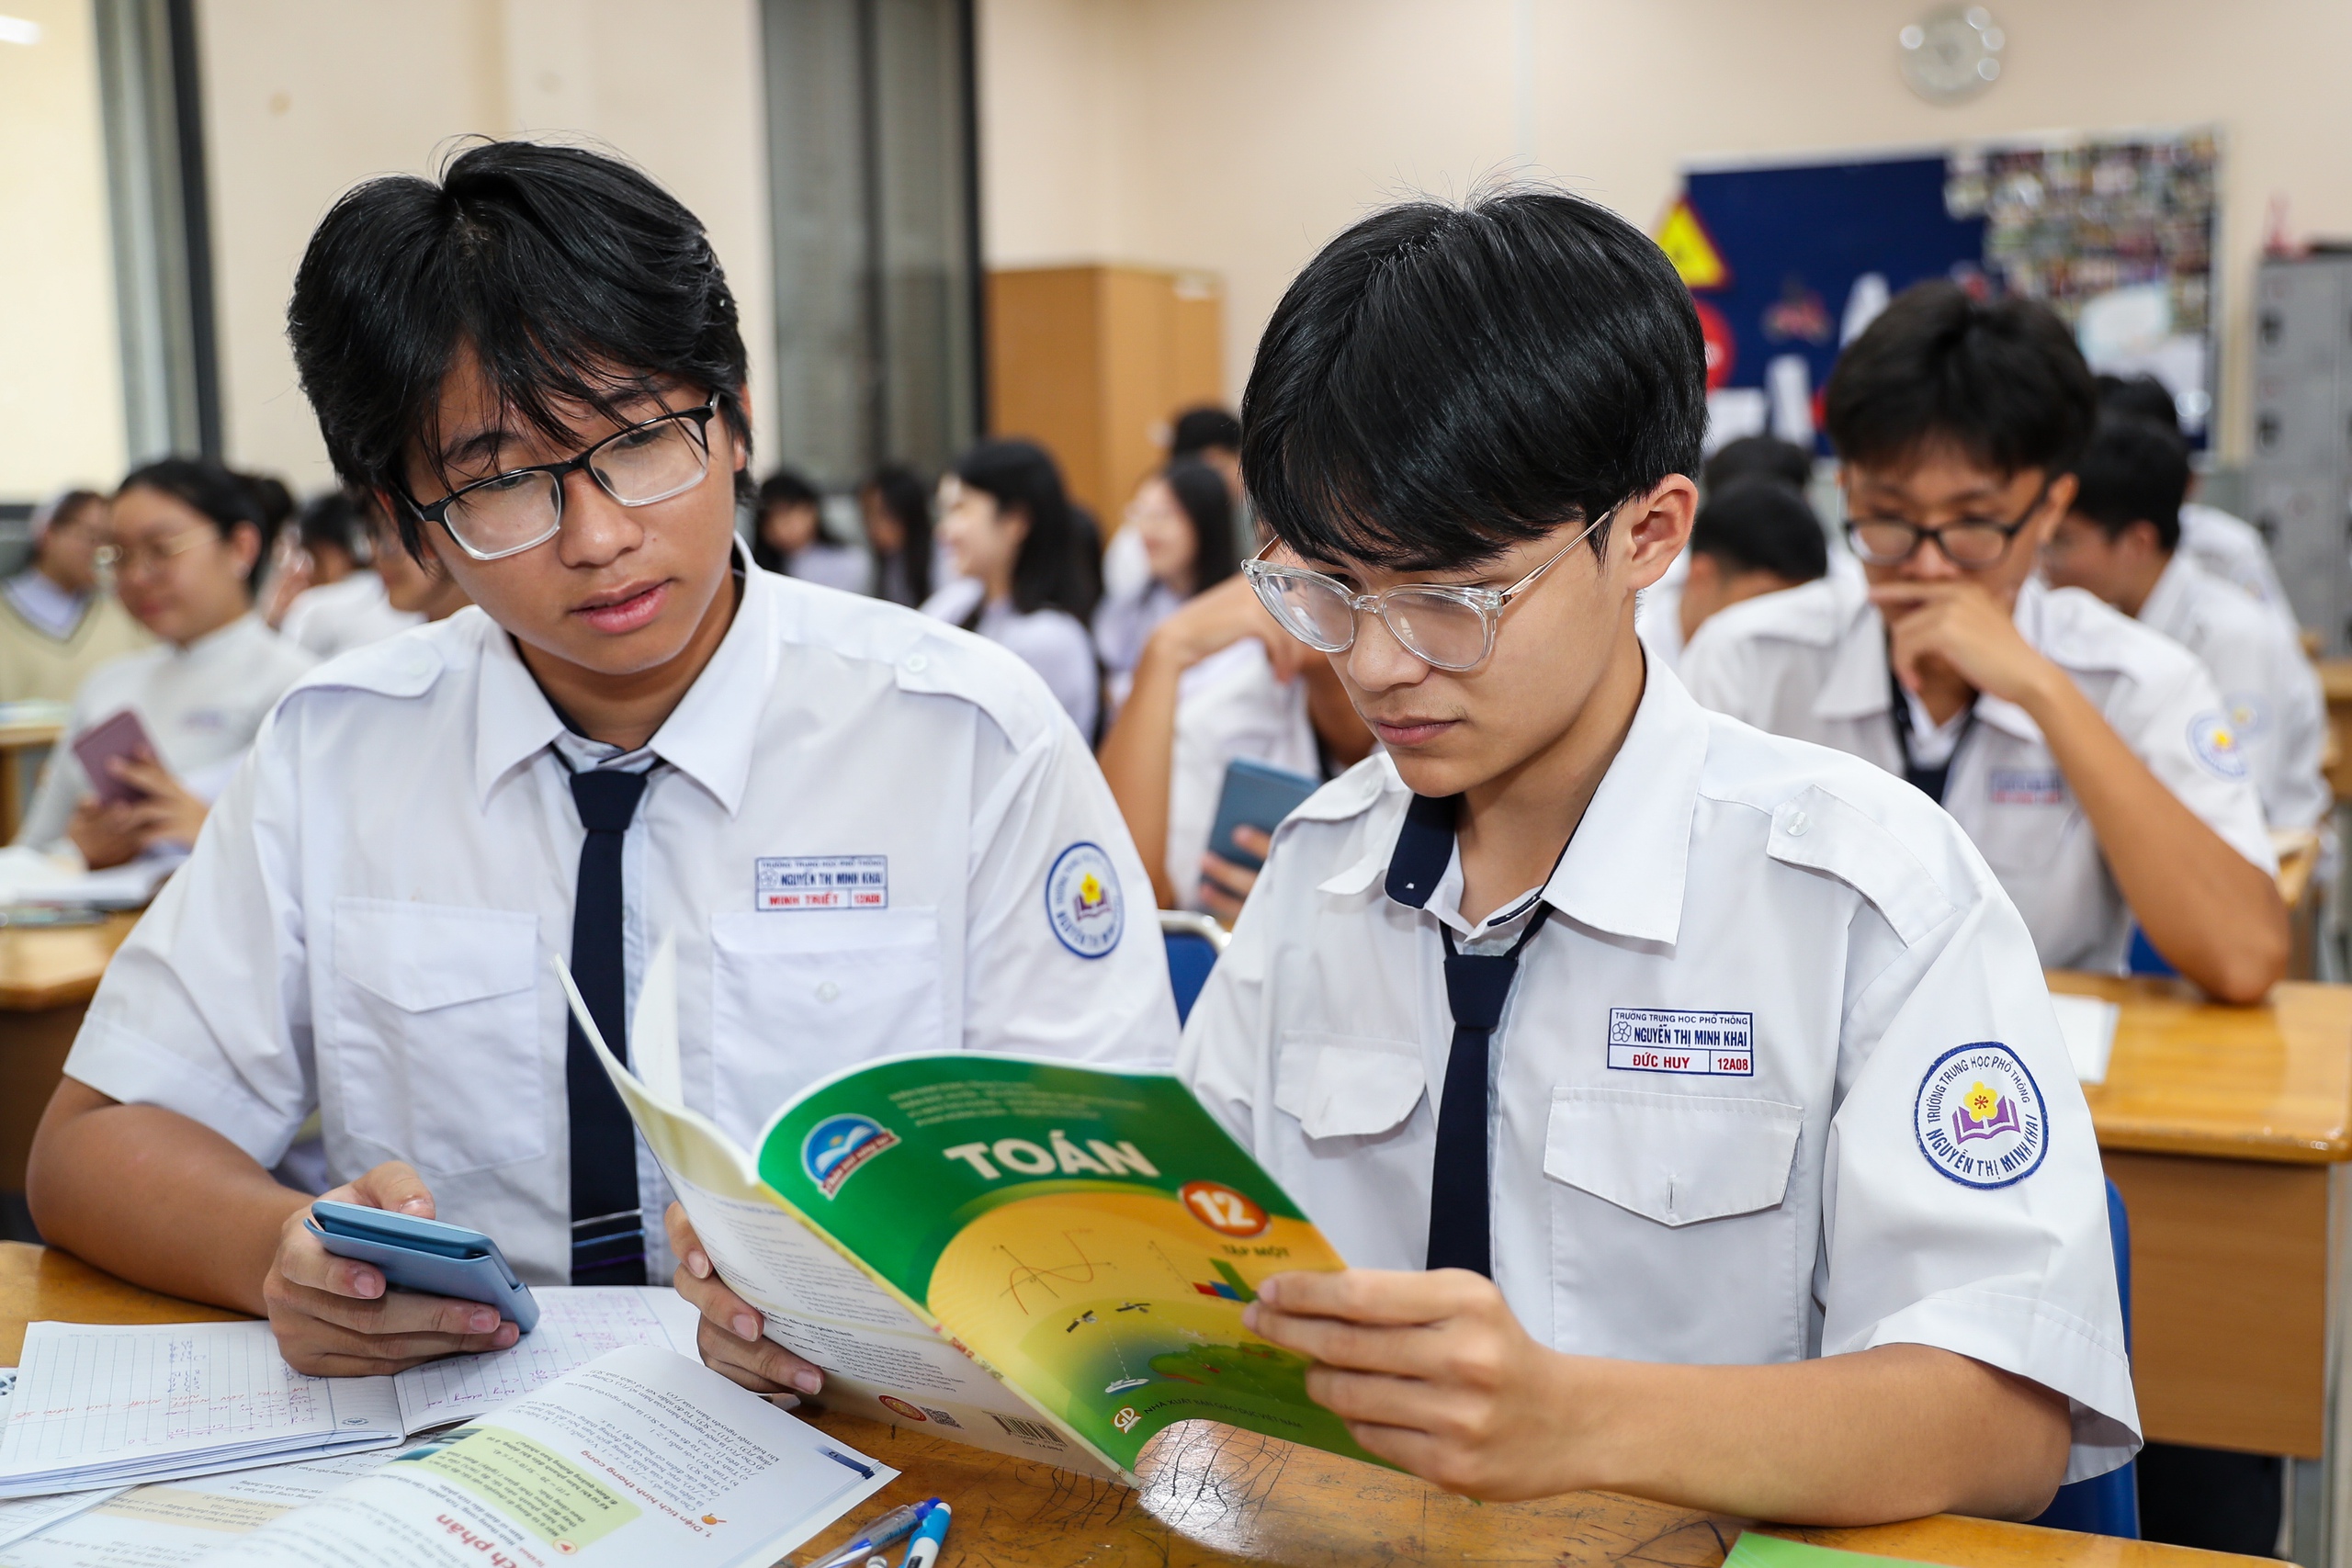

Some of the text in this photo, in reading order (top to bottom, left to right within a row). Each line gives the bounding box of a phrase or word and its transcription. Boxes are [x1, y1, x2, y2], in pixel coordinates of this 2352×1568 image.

[836, 872, 858, 885] MINH
[1615, 1010, 1747, 1025] TRƯỜNG TRUNG HỌC PHỔ THÔNG
[1634, 1024, 1747, 1047] NGUYỄN THỊ MINH KHAI
[1633, 1052, 1690, 1069] ĐỨC HUY
[1717, 1058, 1748, 1071] 12A08
[1926, 1055, 2030, 1124] TRƯỜNG TRUNG HỌC PHỔ THÔNG
[1926, 1113, 2039, 1180] NGUYỄN THỊ MINH KHAI
[943, 1129, 1160, 1181] TOÁN
[1189, 1190, 1258, 1227] 12
[578, 1383, 594, 1392] hàm
[595, 1389, 622, 1402] nguyên
[639, 1393, 654, 1402] hàm
[621, 1401, 636, 1410] một
[653, 1400, 666, 1409] của
[1144, 1401, 1168, 1414] NHÀ
[1167, 1397, 1193, 1406] XUẤT
[554, 1406, 576, 1416] vuông
[666, 1408, 680, 1418] hàm
[1114, 1406, 1136, 1429] GD
[568, 1419, 581, 1428] bởi
[605, 1422, 616, 1430] và
[681, 1417, 706, 1434] nguyên
[582, 1427, 595, 1436] hạn
[622, 1432, 633, 1440] độ
[667, 1429, 681, 1438] suy
[683, 1401, 779, 1463] khi biết một nguyên hàm của
[596, 1435, 612, 1444] giới
[680, 1437, 690, 1445] đó
[705, 1433, 719, 1442] một
[515, 1441, 540, 1453] nhiêu?
[611, 1444, 631, 1459] thang
[621, 1442, 634, 1451] hai
[634, 1439, 655, 1455] hoành
[690, 1444, 700, 1453] Từ
[520, 1450, 532, 1459] khi
[540, 1452, 553, 1461] bao
[581, 1450, 605, 1467] cong
[633, 1449, 643, 1458] và
[532, 1457, 545, 1466] đến
[633, 1459, 650, 1471] hình
[644, 1457, 666, 1472] hoành
[668, 1440, 740, 1487] b) Tính S(x) với mỗi
[741, 1456, 756, 1466] Cho
[545, 1465, 568, 1479] phanh
[553, 1460, 574, 1474] đường
[666, 1461, 684, 1473] điểm
[722, 1464, 739, 1476] Tính
[331, 1469, 353, 1477] dương
[606, 1467, 635, 1488] thang
[650, 1471, 663, 1480] của
[667, 1472, 681, 1482] trục
[684, 1473, 697, 1483] các
[566, 1479, 582, 1490] hãm
[573, 1473, 594, 1488] quãng
[664, 1480, 678, 1490] tích
[704, 1474, 719, 1486] Tính
[697, 1482, 707, 1490] tại
[581, 1489, 593, 1498] khi
[594, 1488, 610, 1499] được
[636, 1488, 658, 1504] hình
[679, 1490, 695, 1500] diện
[184, 1506, 209, 1515] đường
[659, 1503, 678, 1517] tích
[680, 1517, 703, 1532] Diện
[436, 1515, 494, 1551] phân
